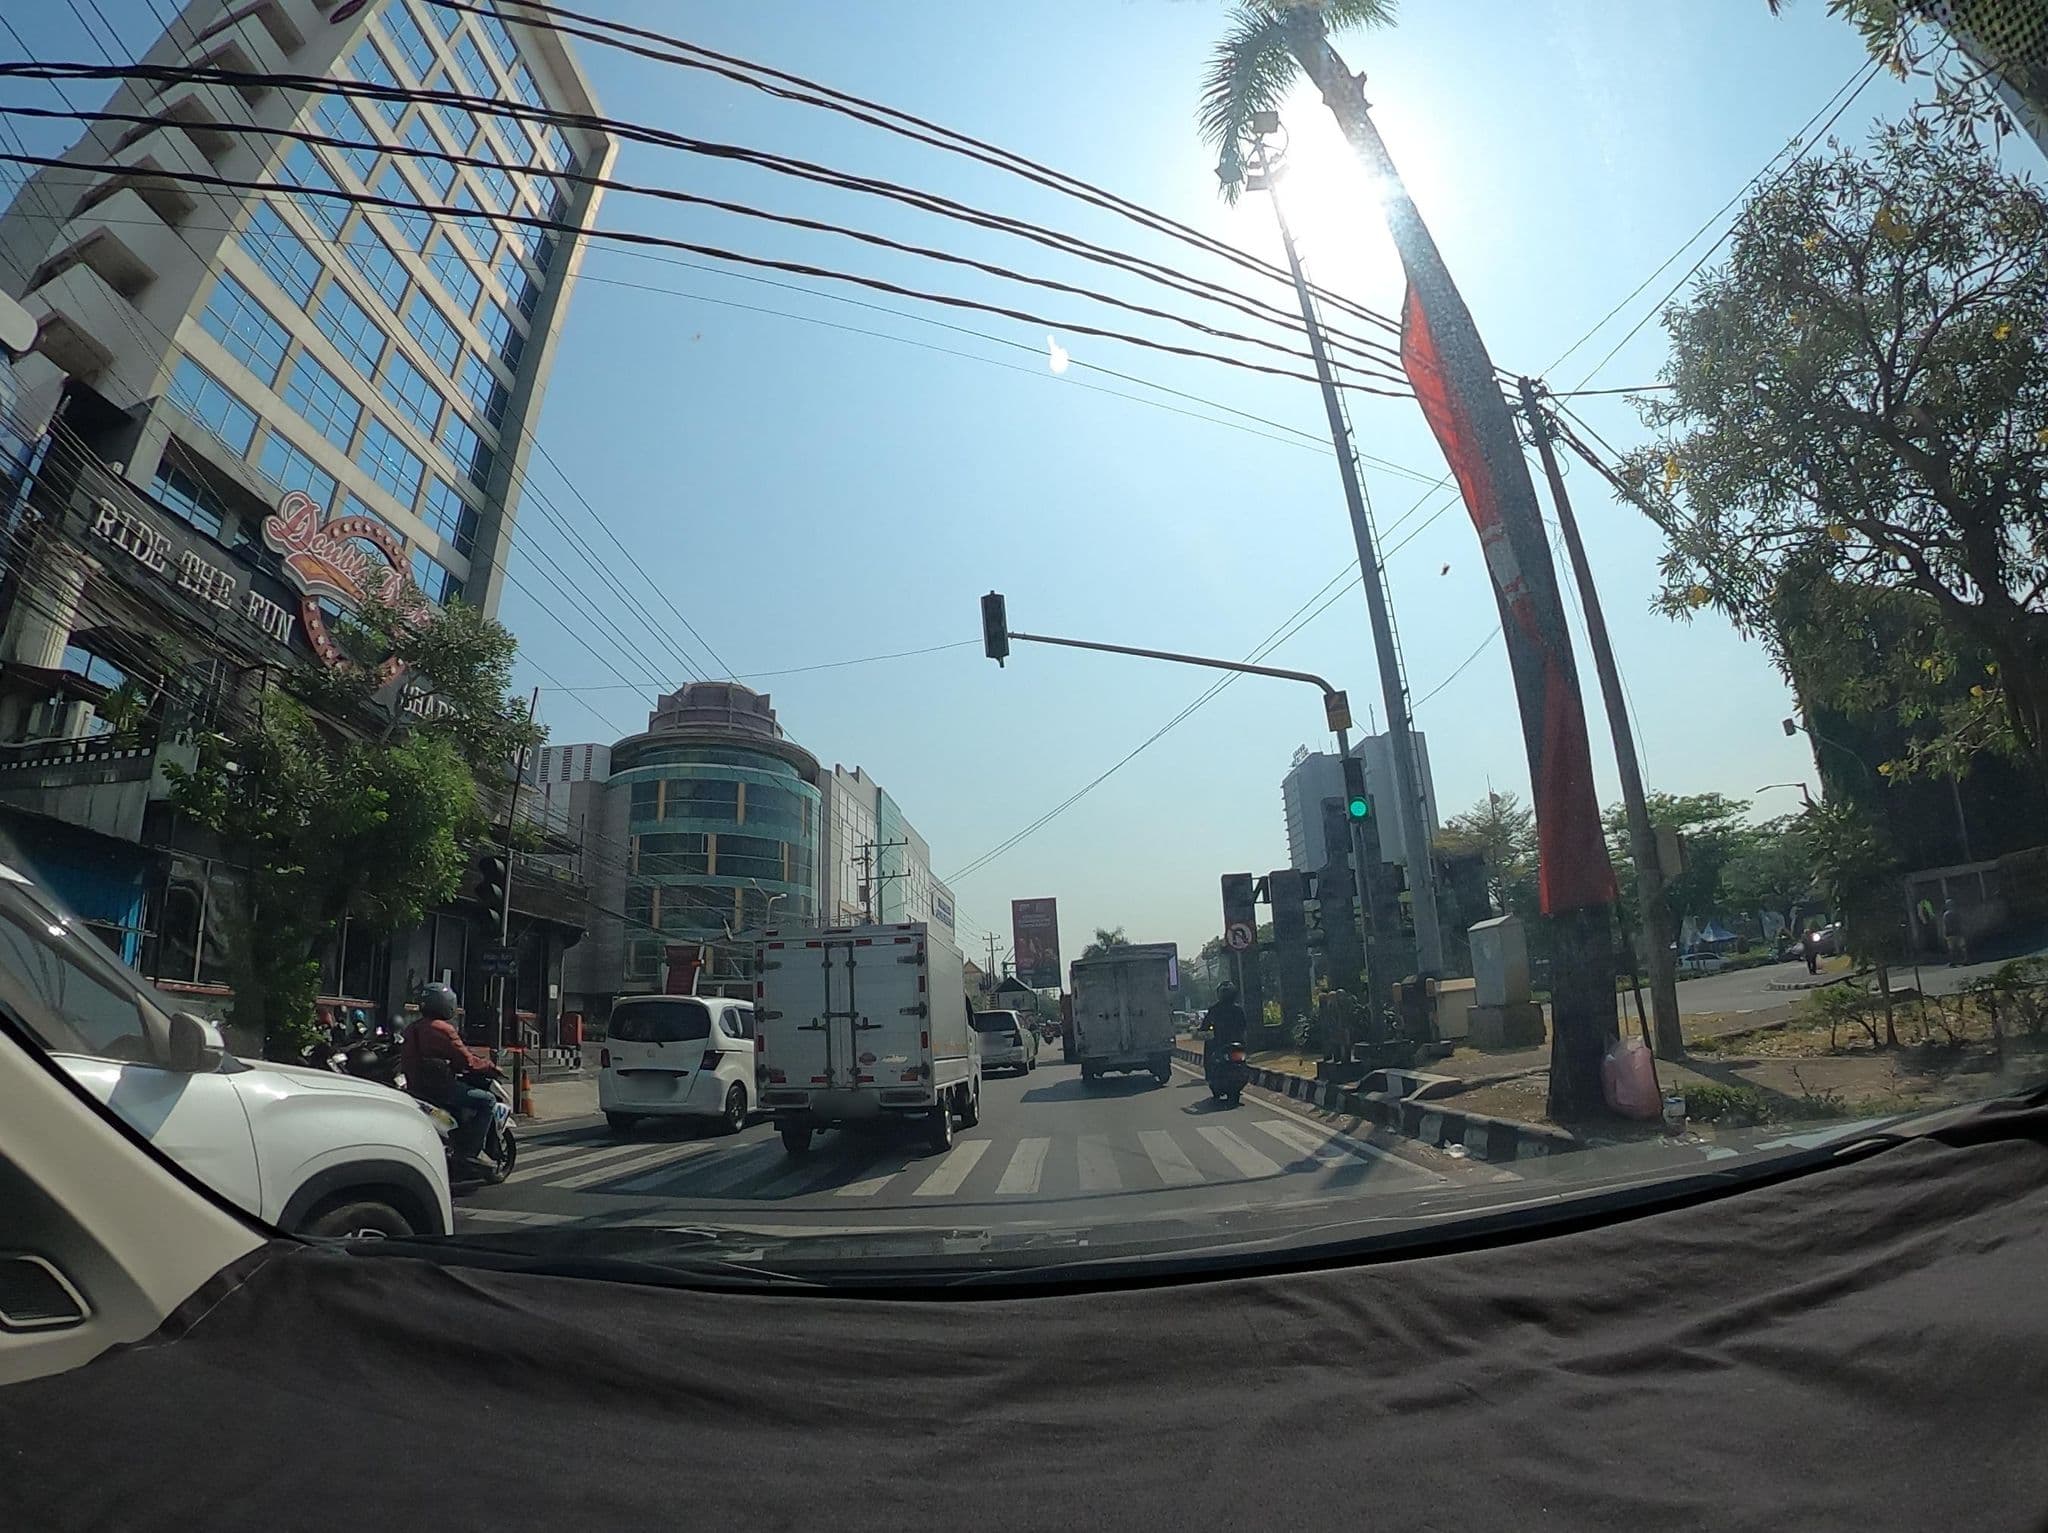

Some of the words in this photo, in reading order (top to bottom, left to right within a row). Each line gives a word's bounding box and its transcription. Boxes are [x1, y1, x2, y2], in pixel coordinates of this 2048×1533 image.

[90, 497, 171, 573] RIDE
[177, 550, 236, 610] THE
[247, 590, 296, 645] FUN
